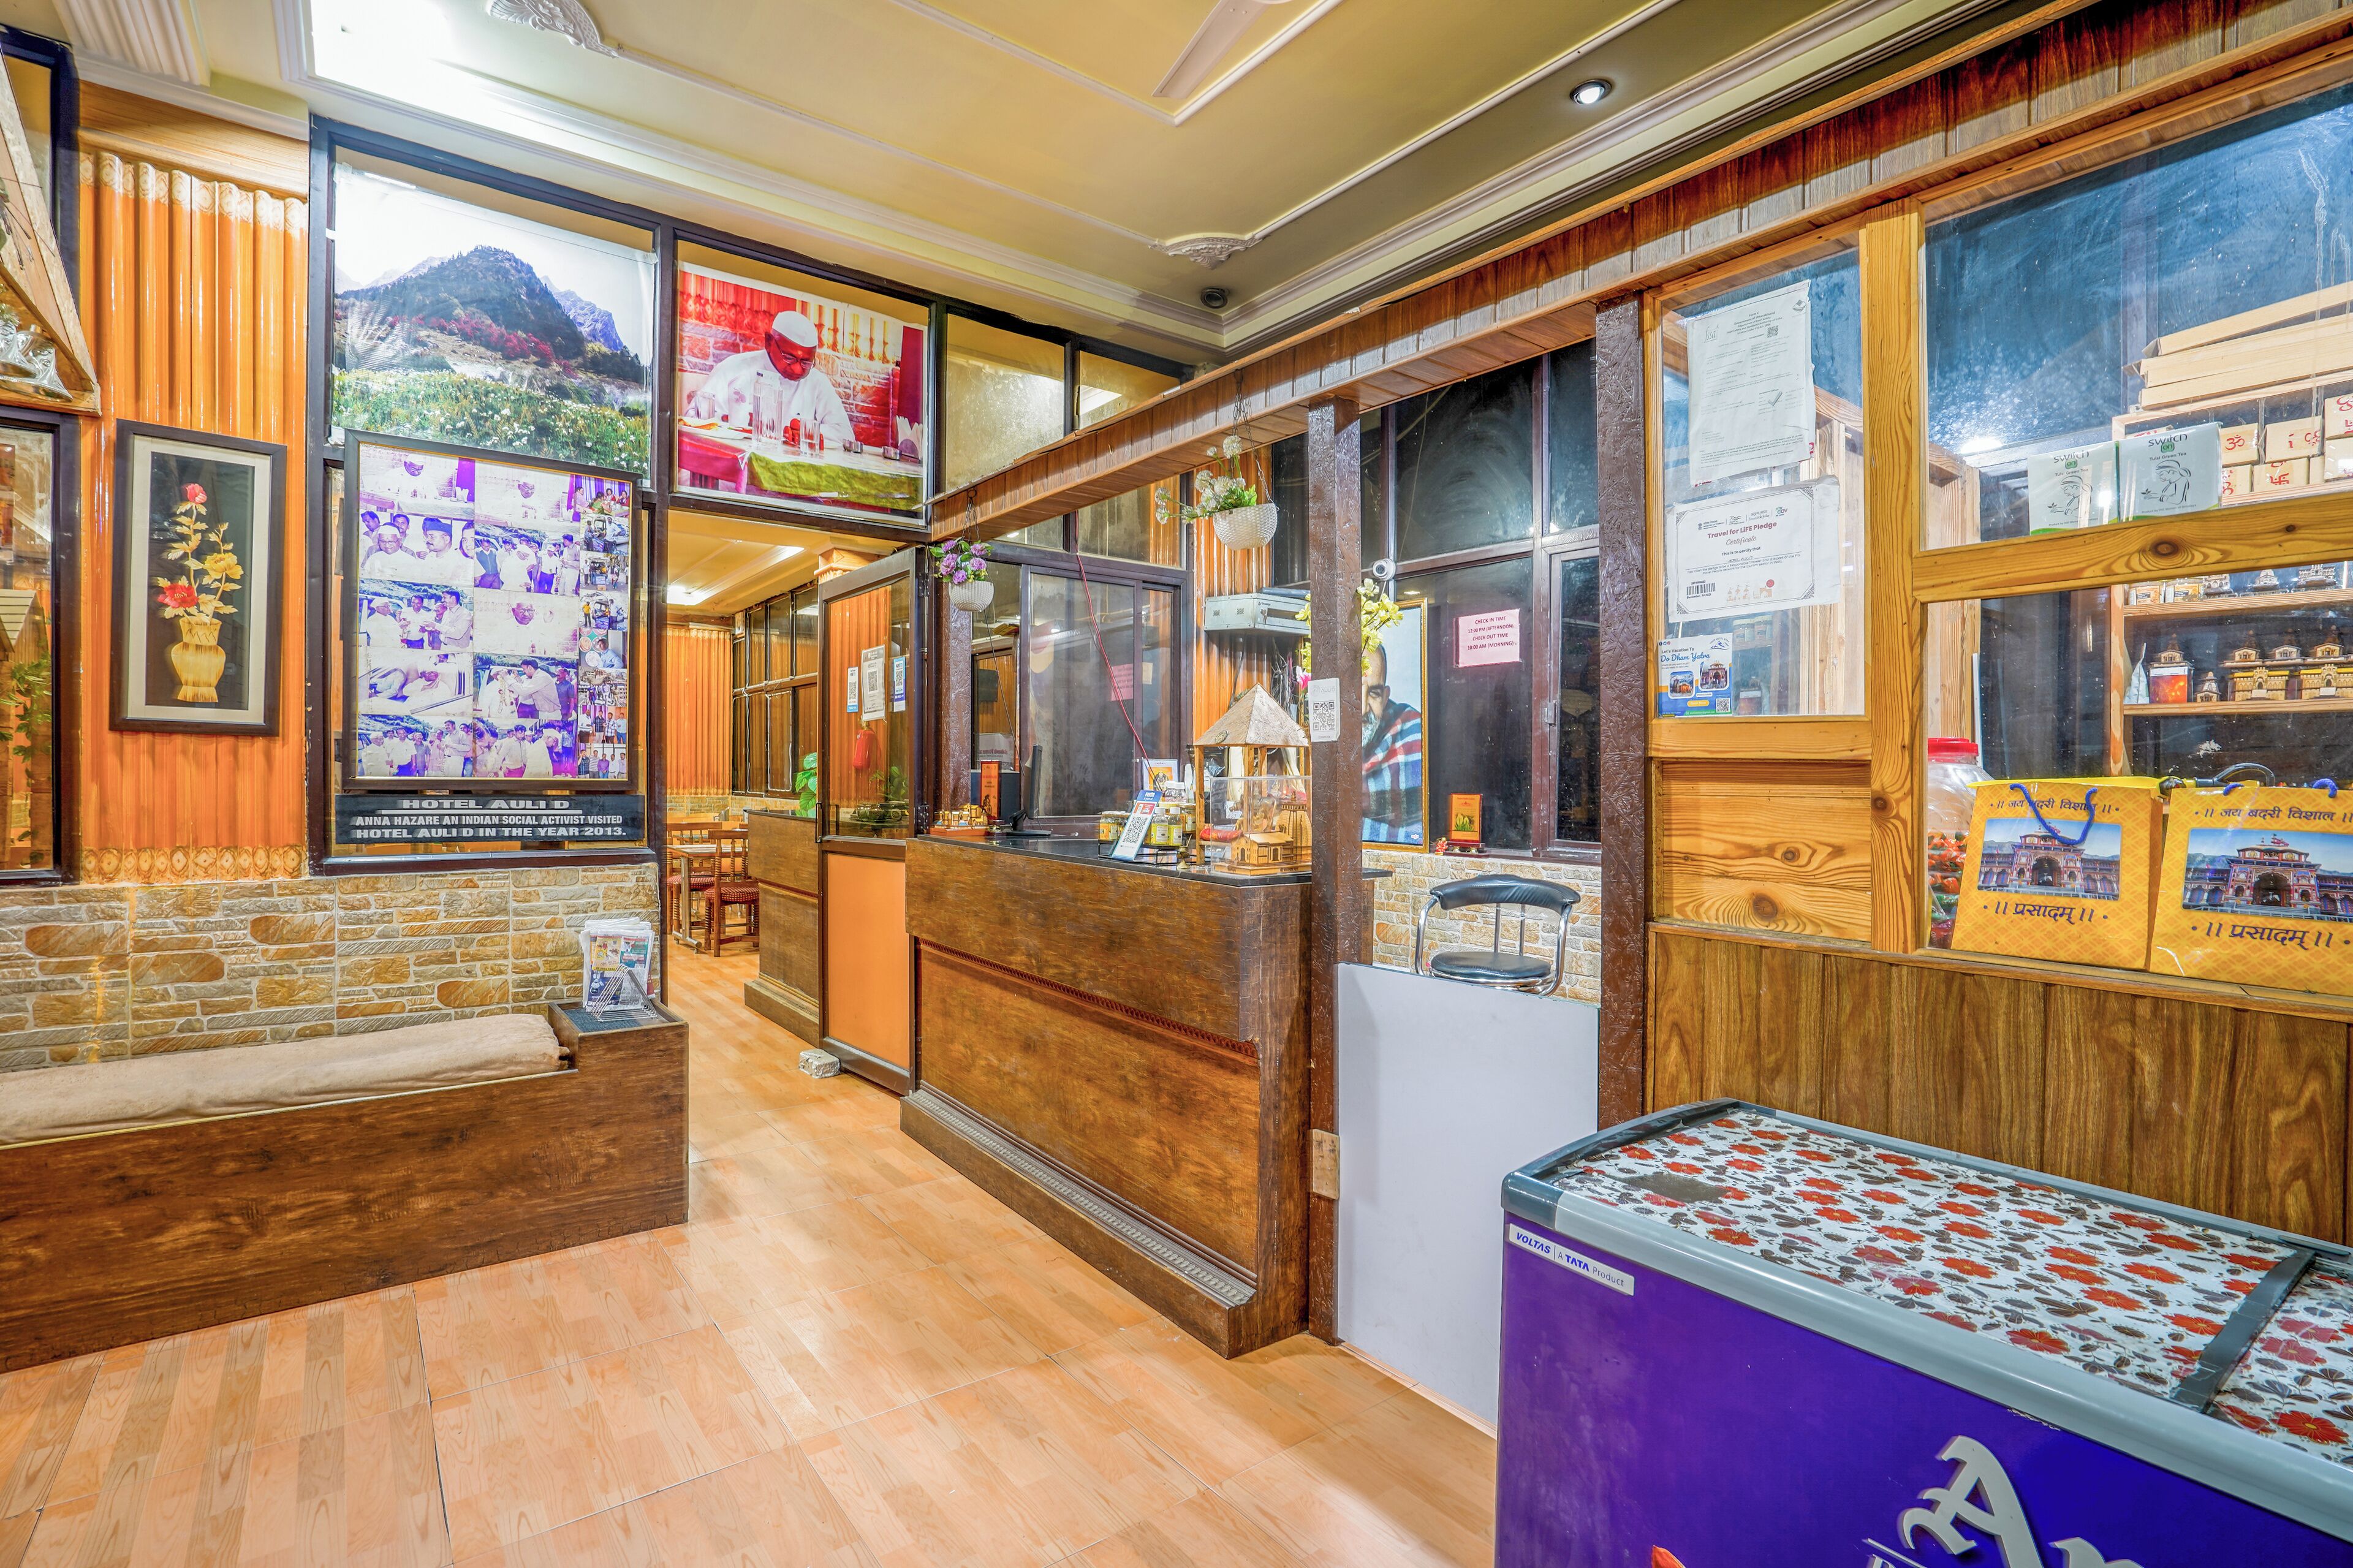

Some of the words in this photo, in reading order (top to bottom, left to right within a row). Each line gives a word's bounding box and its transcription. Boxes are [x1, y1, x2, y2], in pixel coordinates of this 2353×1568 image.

[1707, 530, 1729, 539] Travel
[1754, 521, 1777, 530] Pledge
[1726, 536, 1757, 545] Certificate
[1691, 652, 1710, 662] Yatra
[403, 800, 483, 809] HOTEL
[490, 800, 547, 809] AULI
[554, 800, 570, 809] D
[2028, 798, 2055, 810] दरी
[2220, 808, 2242, 817] जय
[2248, 806, 2282, 820] बदरी
[2287, 806, 2335, 821] विशाल
[355, 816, 391, 826] ANNA
[394, 816, 439, 825] HAZARE
[442, 816, 459, 825] AN
[462, 816, 499, 825] INDIAN
[502, 816, 538, 825] SOCIAL
[541, 816, 586, 825] ACTIVIST
[588, 816, 623, 824] VISITED
[356, 829, 412, 839] HOTEL
[417, 828, 457, 838] AULI
[463, 828, 474, 838] D
[479, 828, 496, 837] IN
[502, 827, 532, 836] THE
[537, 827, 580, 836] YEAR
[584, 827, 626, 836] 2013.
[2012, 903, 2076, 925] प्रसादम्
[2229, 925, 2309, 950] प्रसादम्
[1516, 1232, 1551, 1254] VOLTAS
[1558, 1251, 1563, 1260] A
[1565, 1254, 1590, 1271] TATA
[1593, 1267, 1624, 1287] Product
[1898, 1434, 2146, 1568] A
